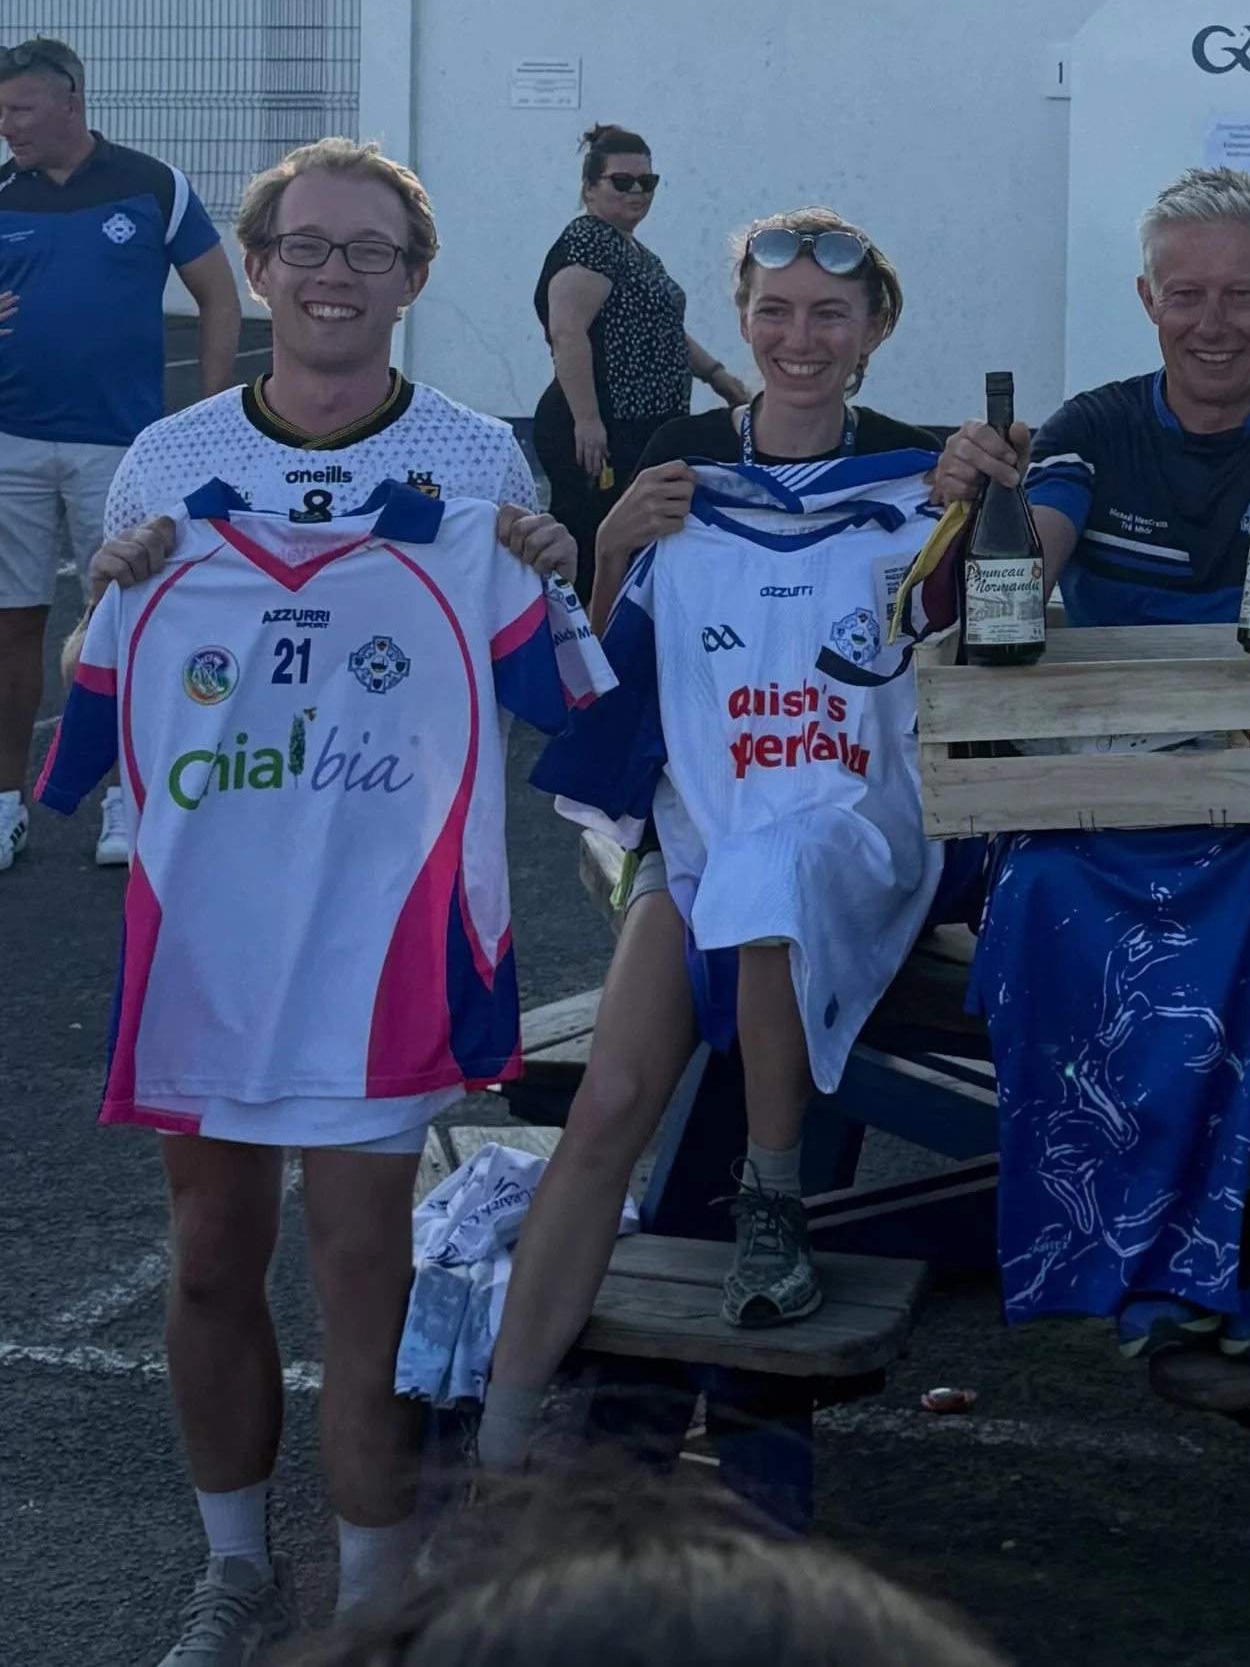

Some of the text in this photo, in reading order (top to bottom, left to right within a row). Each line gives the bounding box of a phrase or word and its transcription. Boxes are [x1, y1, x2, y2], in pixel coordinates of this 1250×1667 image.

[759, 585, 814, 598] azzurri
[262, 608, 331, 624] AZZURRI
[271, 637, 312, 685] 21
[168, 725, 415, 810] Chia bia
